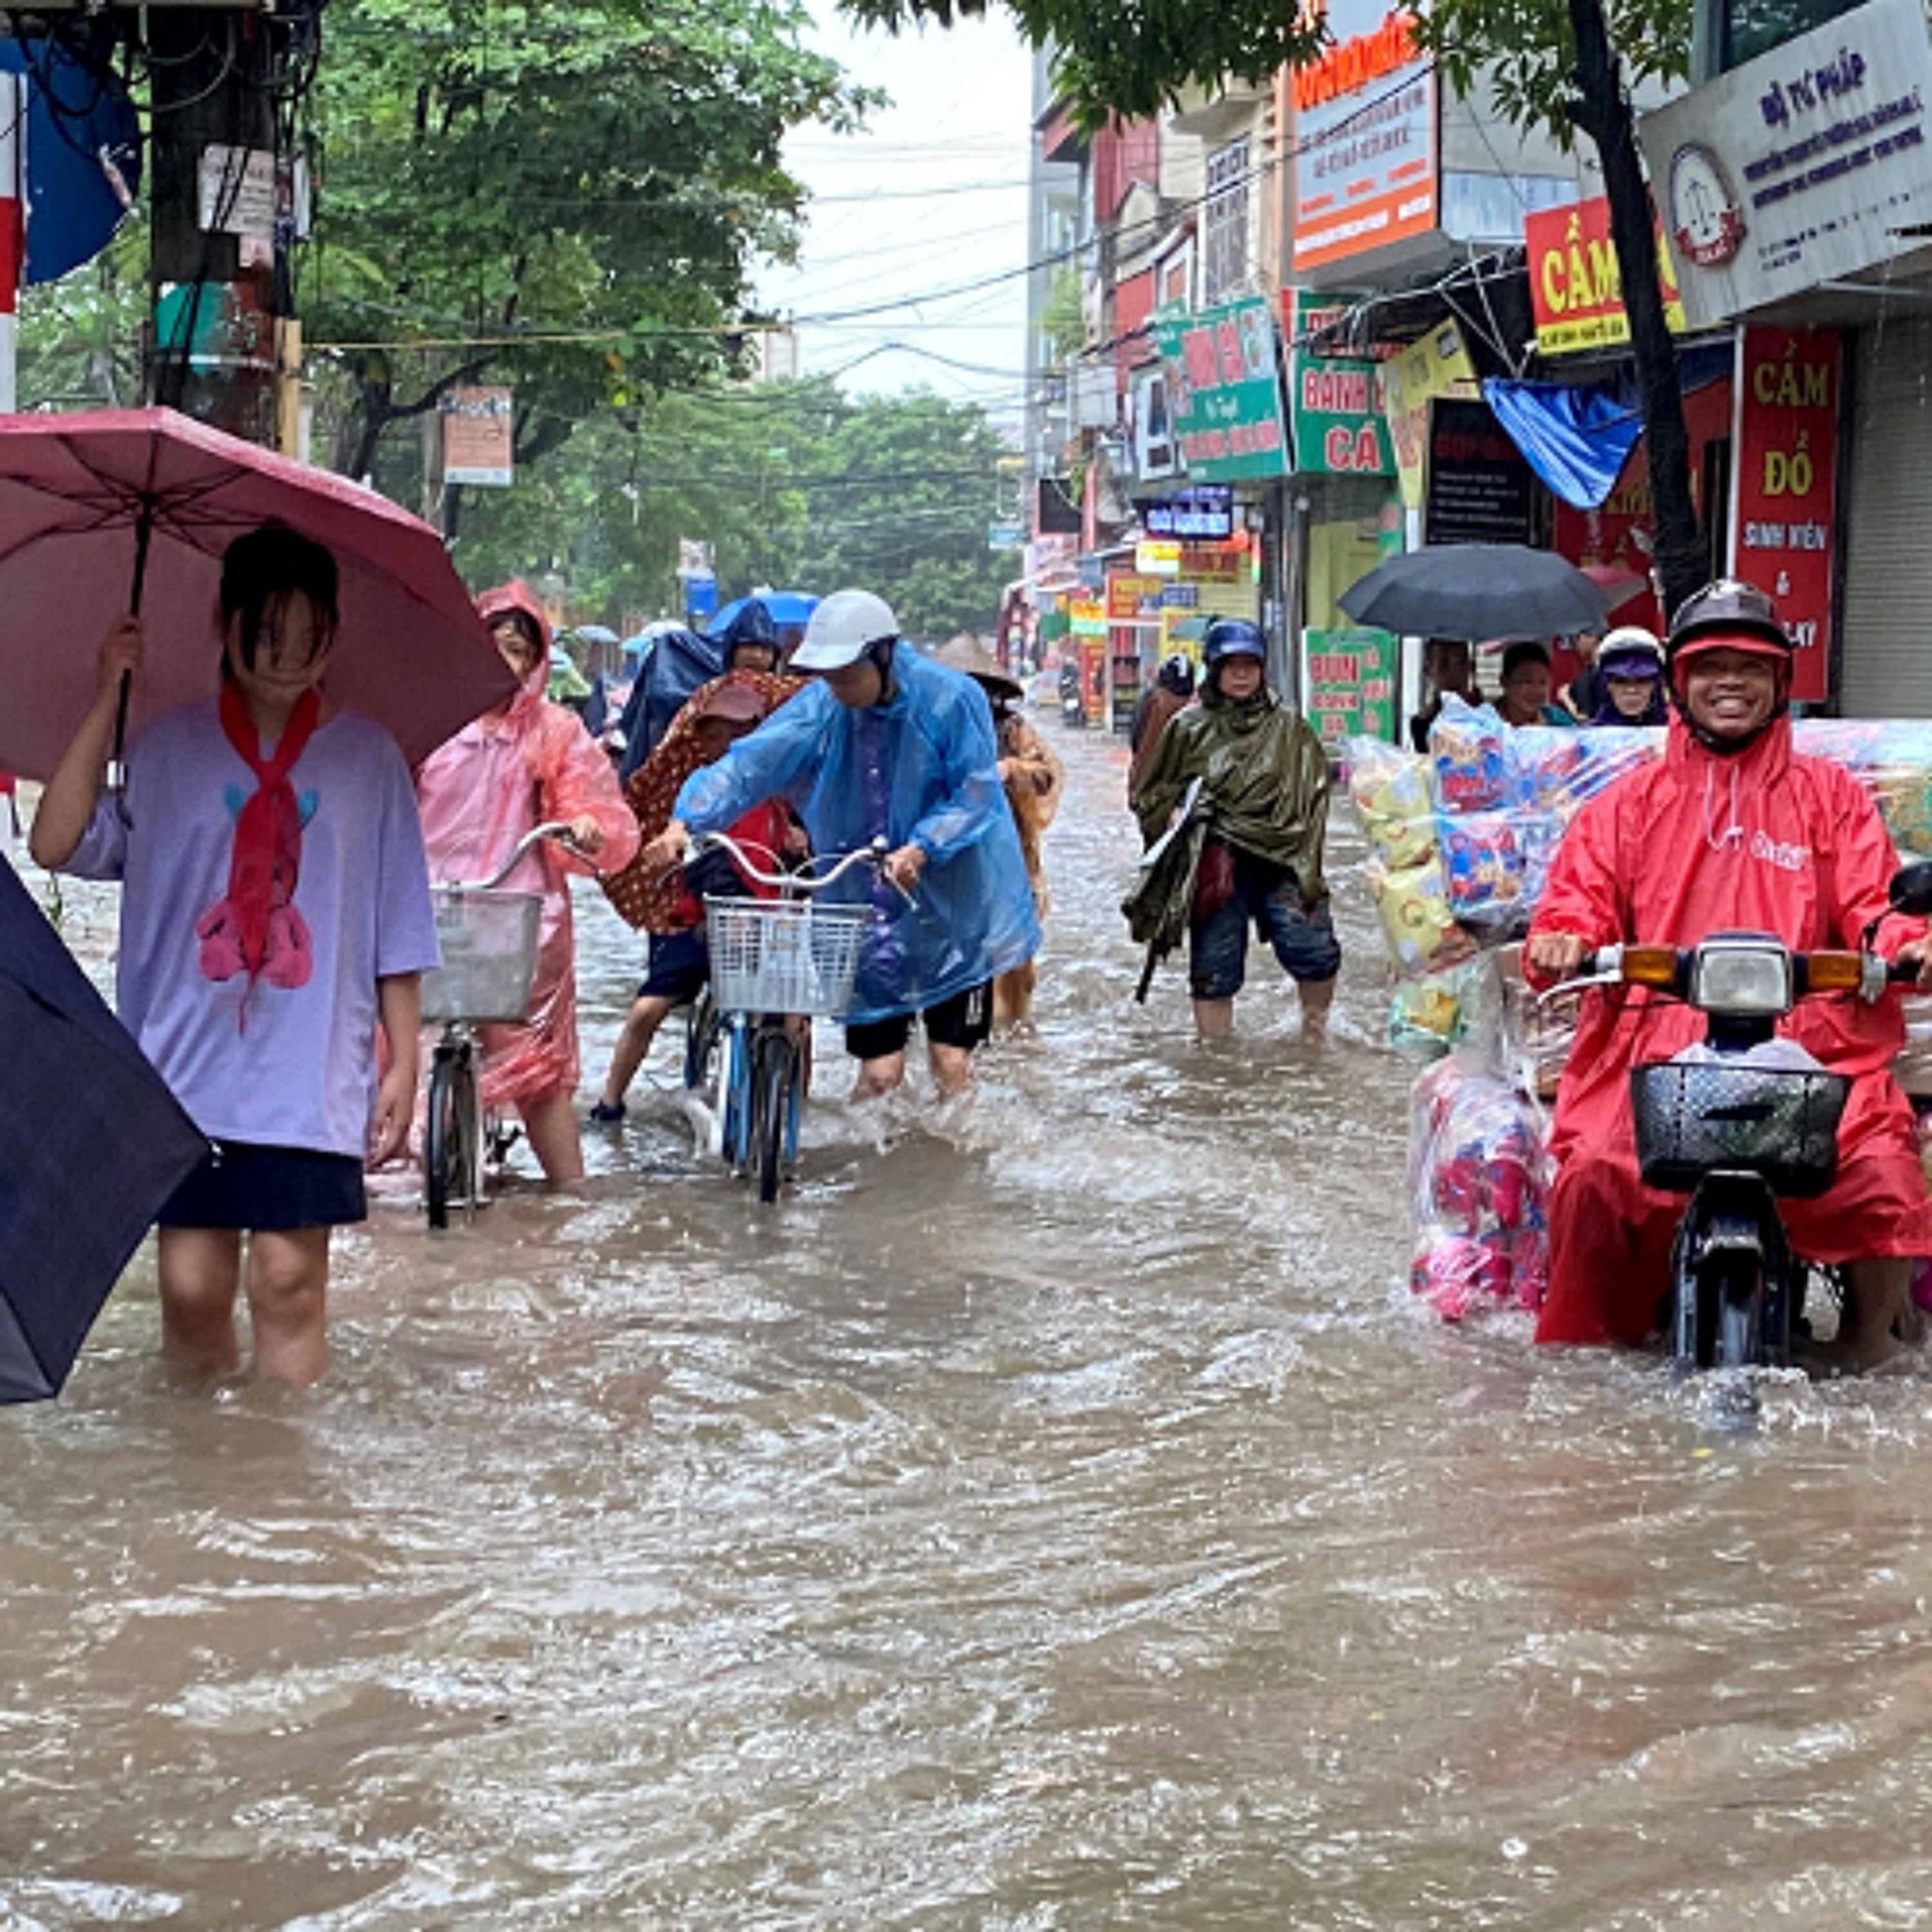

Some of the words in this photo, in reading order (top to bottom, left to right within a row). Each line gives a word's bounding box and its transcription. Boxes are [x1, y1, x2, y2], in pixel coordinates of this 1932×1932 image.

[1815, 45, 1866, 104] PHÁP
[1303, 362, 1369, 412] BÁNH
[1326, 419, 1381, 471] CÁ
[1763, 428, 1813, 495] ĐỒ
[1743, 520, 1785, 547] SINH
